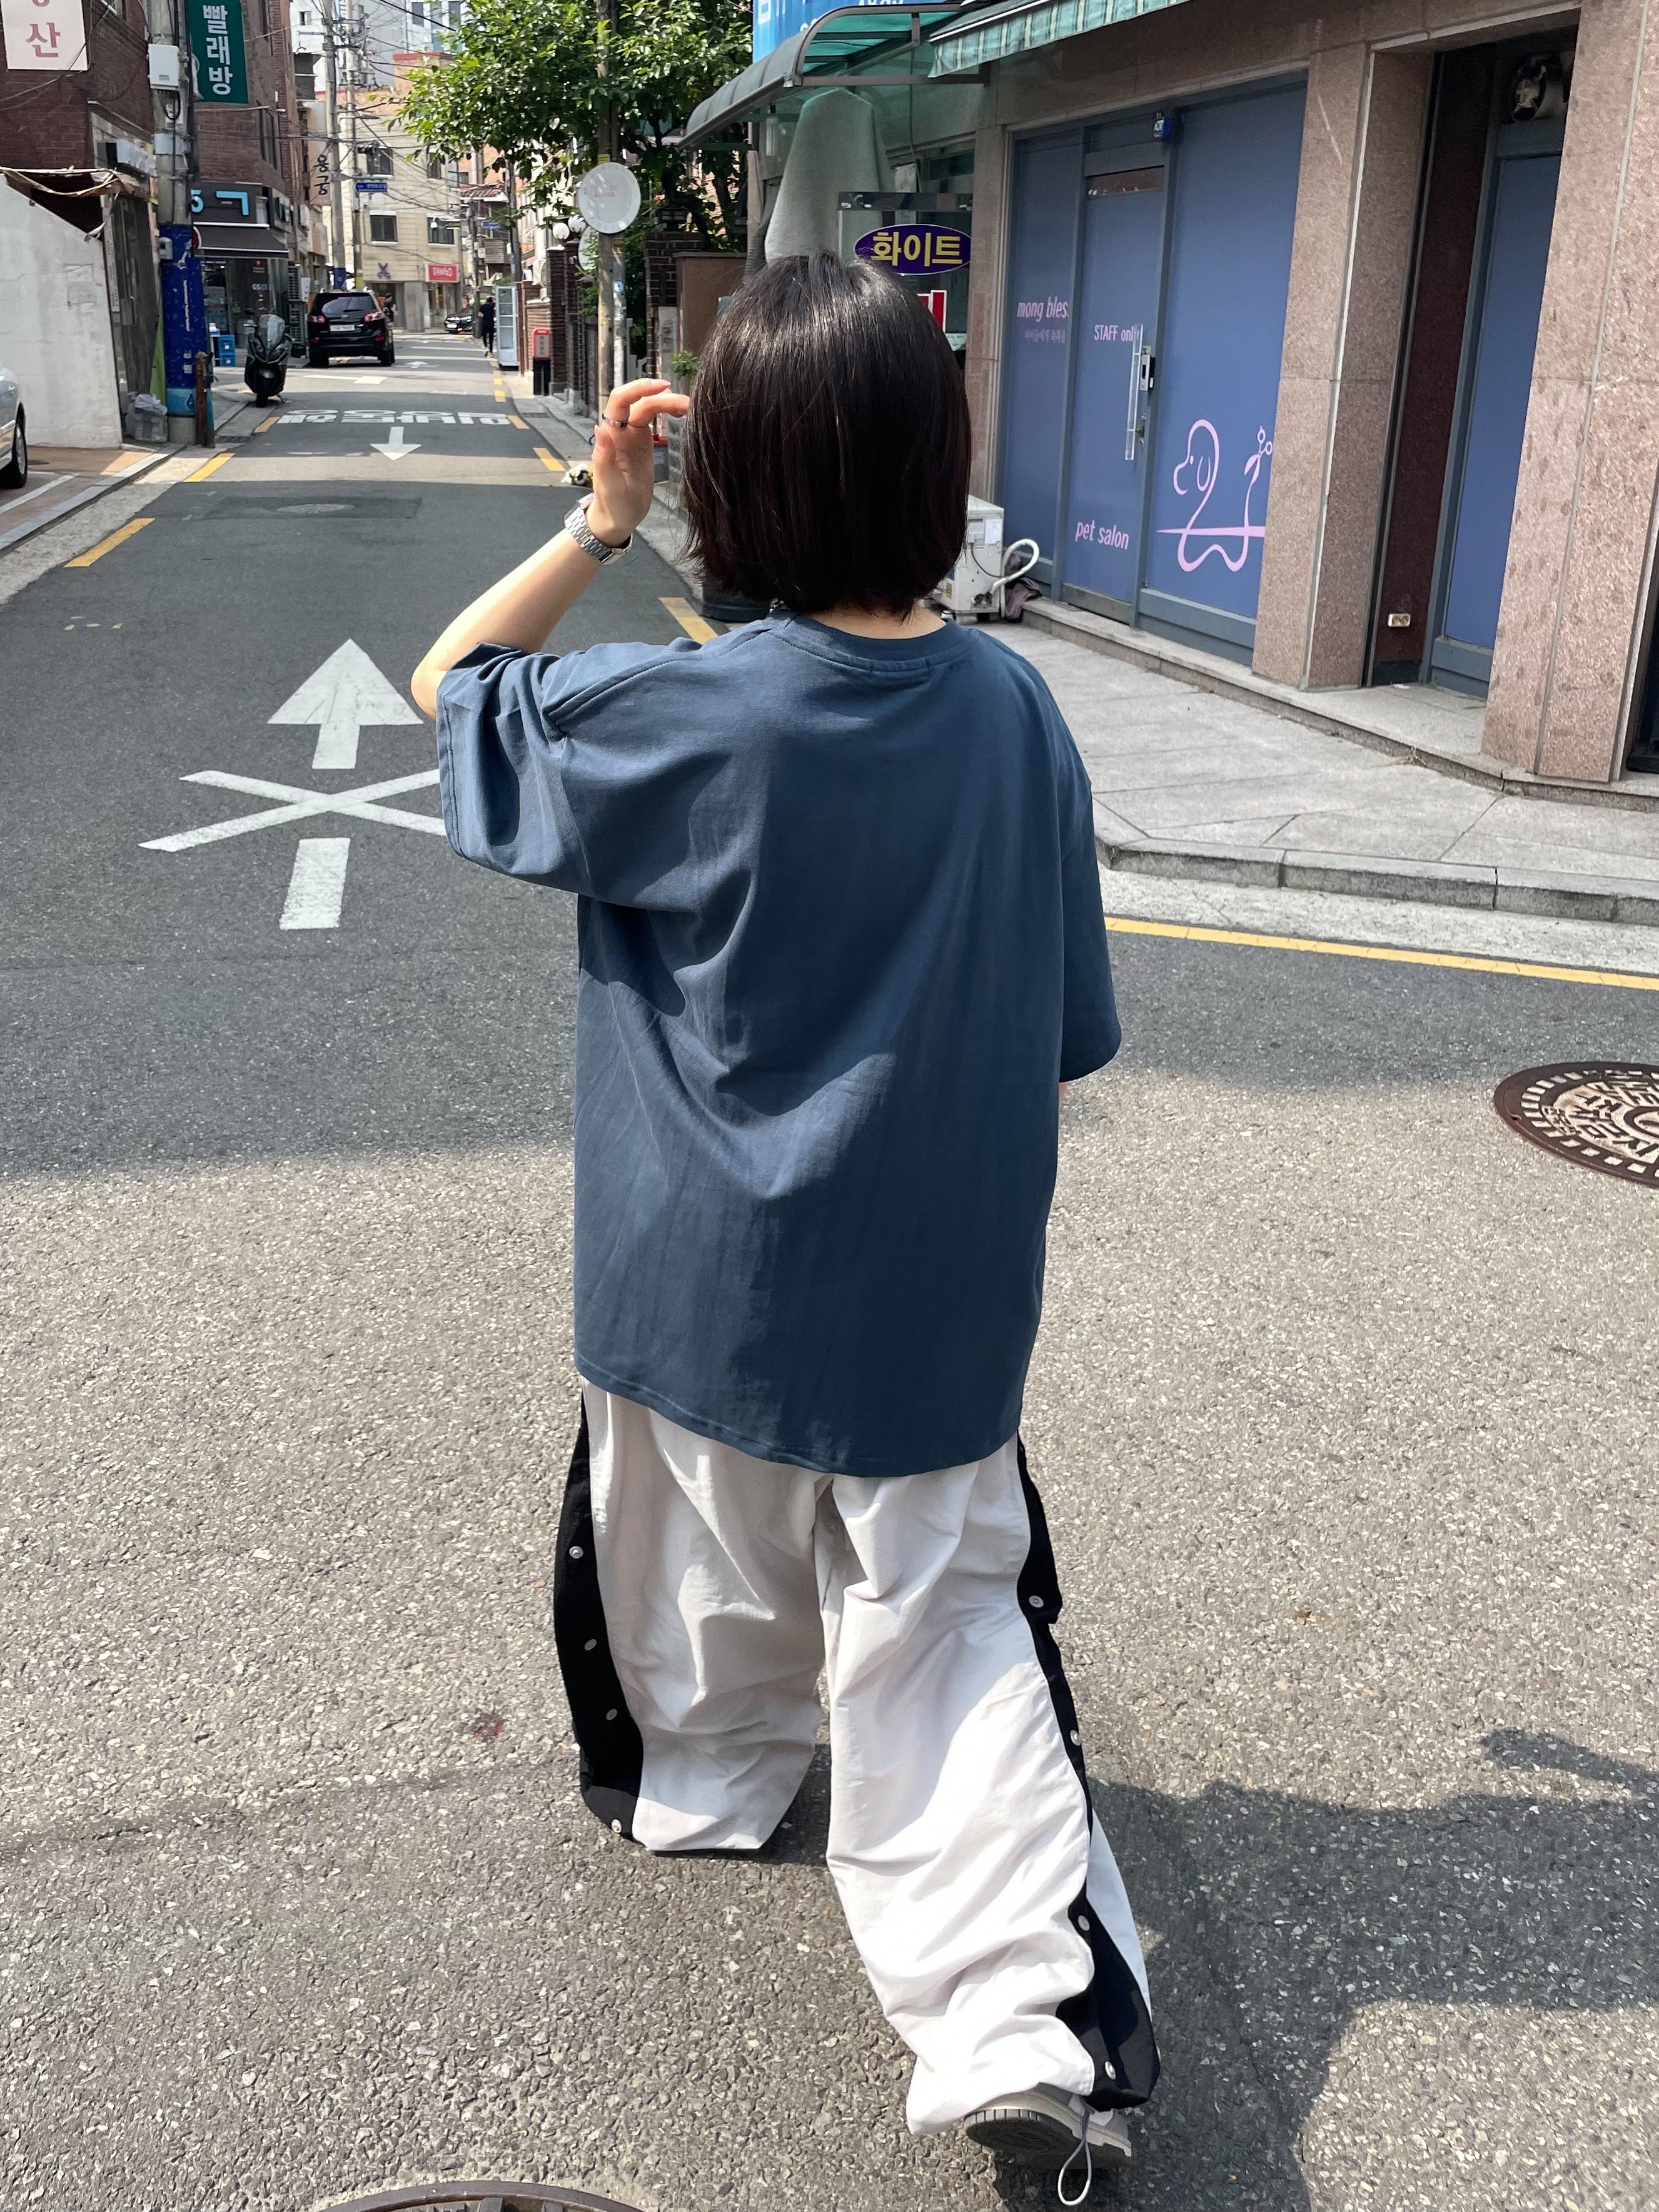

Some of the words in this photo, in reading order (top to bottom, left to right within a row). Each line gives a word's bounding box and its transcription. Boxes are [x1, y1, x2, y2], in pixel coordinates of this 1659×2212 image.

[26, 0, 61, 58] 산
[203, 4, 231, 96] 빨래방
[313, 154, 331, 196] 용궁
[870, 231, 963, 267] 화이트
[1016, 301, 1044, 322] mong
[1046, 295, 1069, 318] bles
[1094, 325, 1119, 341] STAFF
[276, 409, 512, 426] 일방통행
[1075, 520, 1096, 543] pet
[1097, 525, 1129, 550] salon
